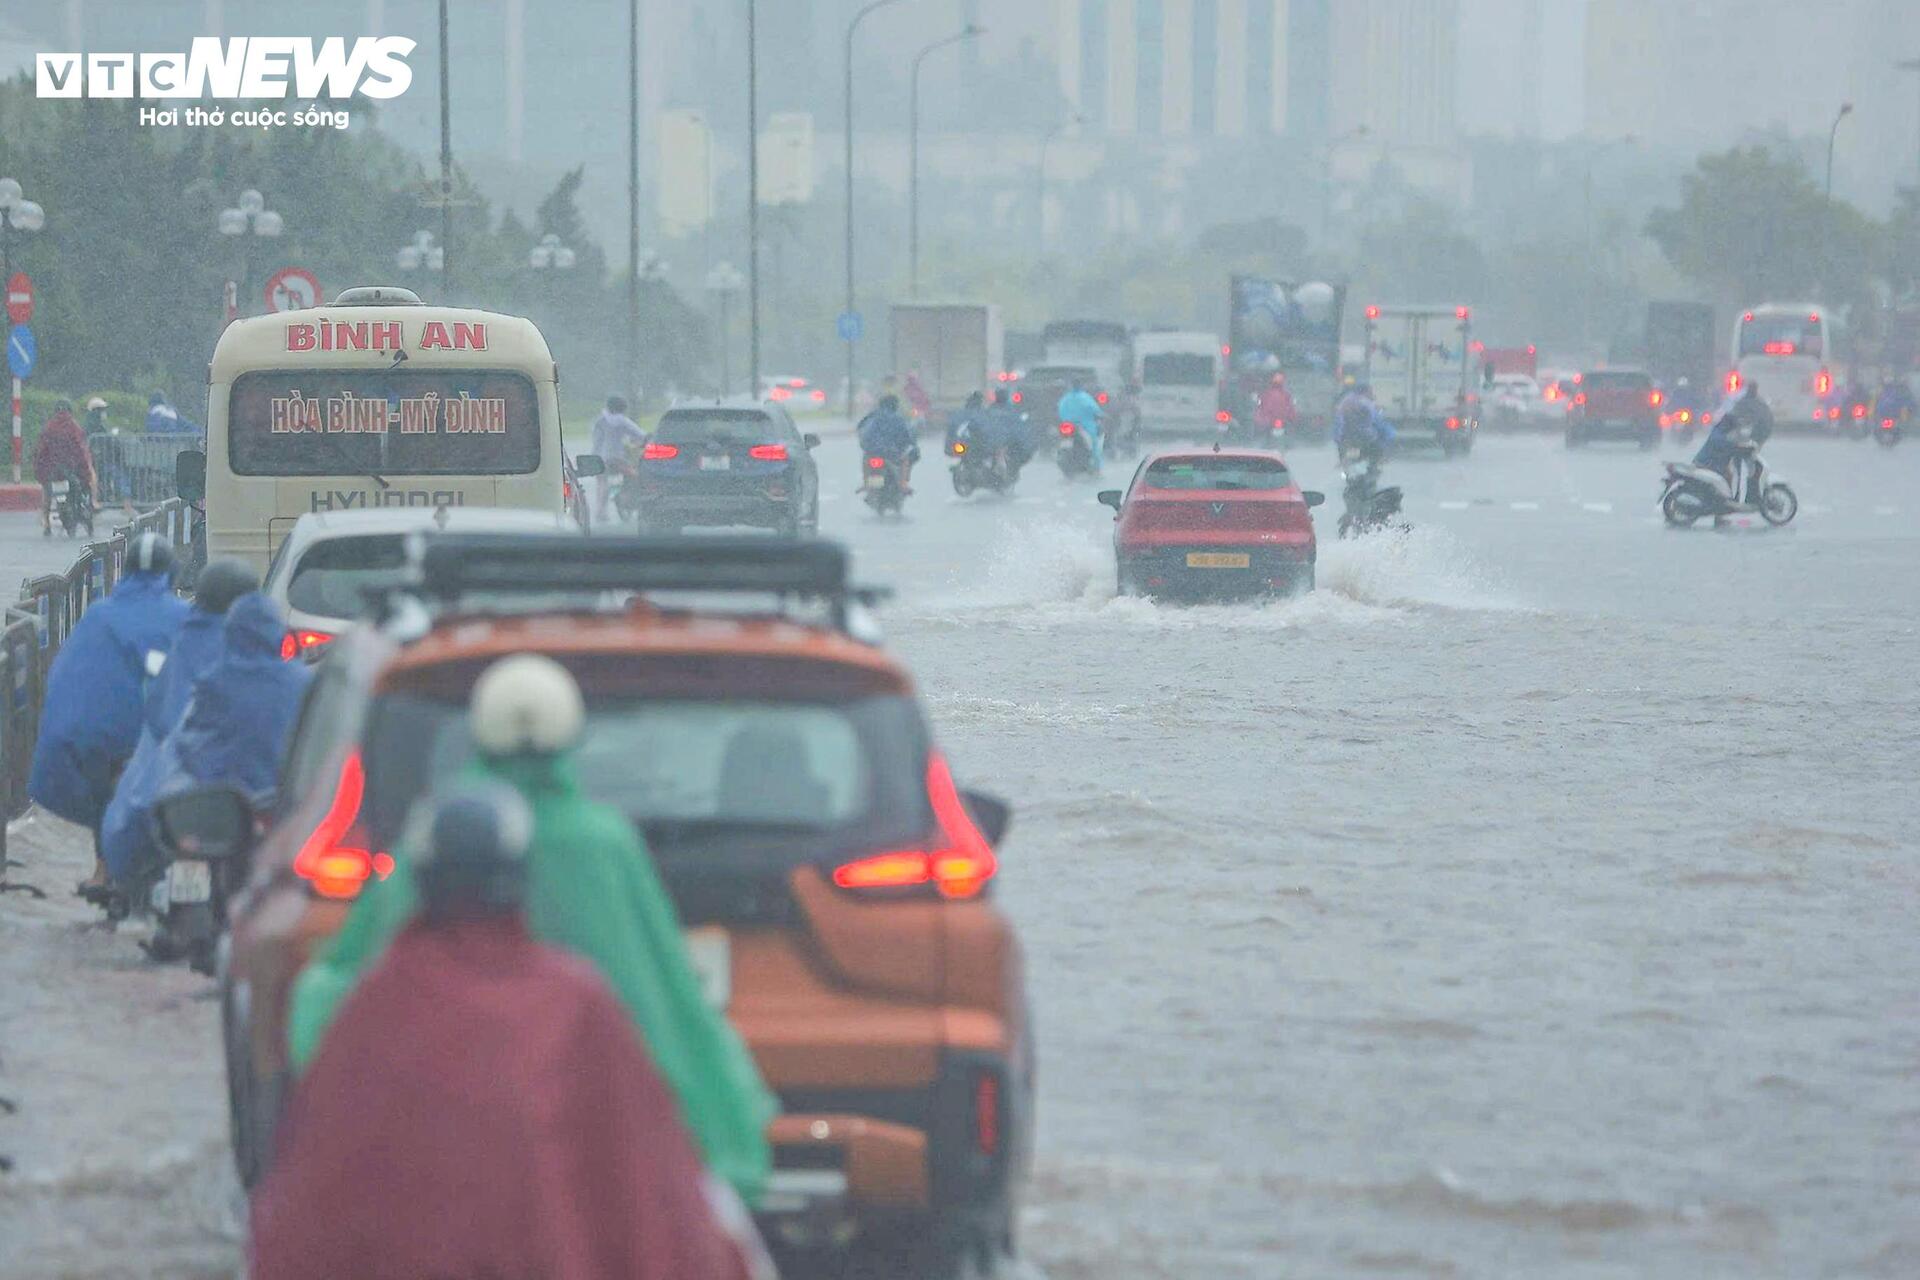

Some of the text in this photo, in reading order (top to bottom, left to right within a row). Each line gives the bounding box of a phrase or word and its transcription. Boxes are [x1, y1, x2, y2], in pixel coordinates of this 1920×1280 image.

[286, 318, 488, 352] BÌNH AN
[271, 390, 323, 433] HÒA
[445, 391, 506, 433] ĐÌNH
